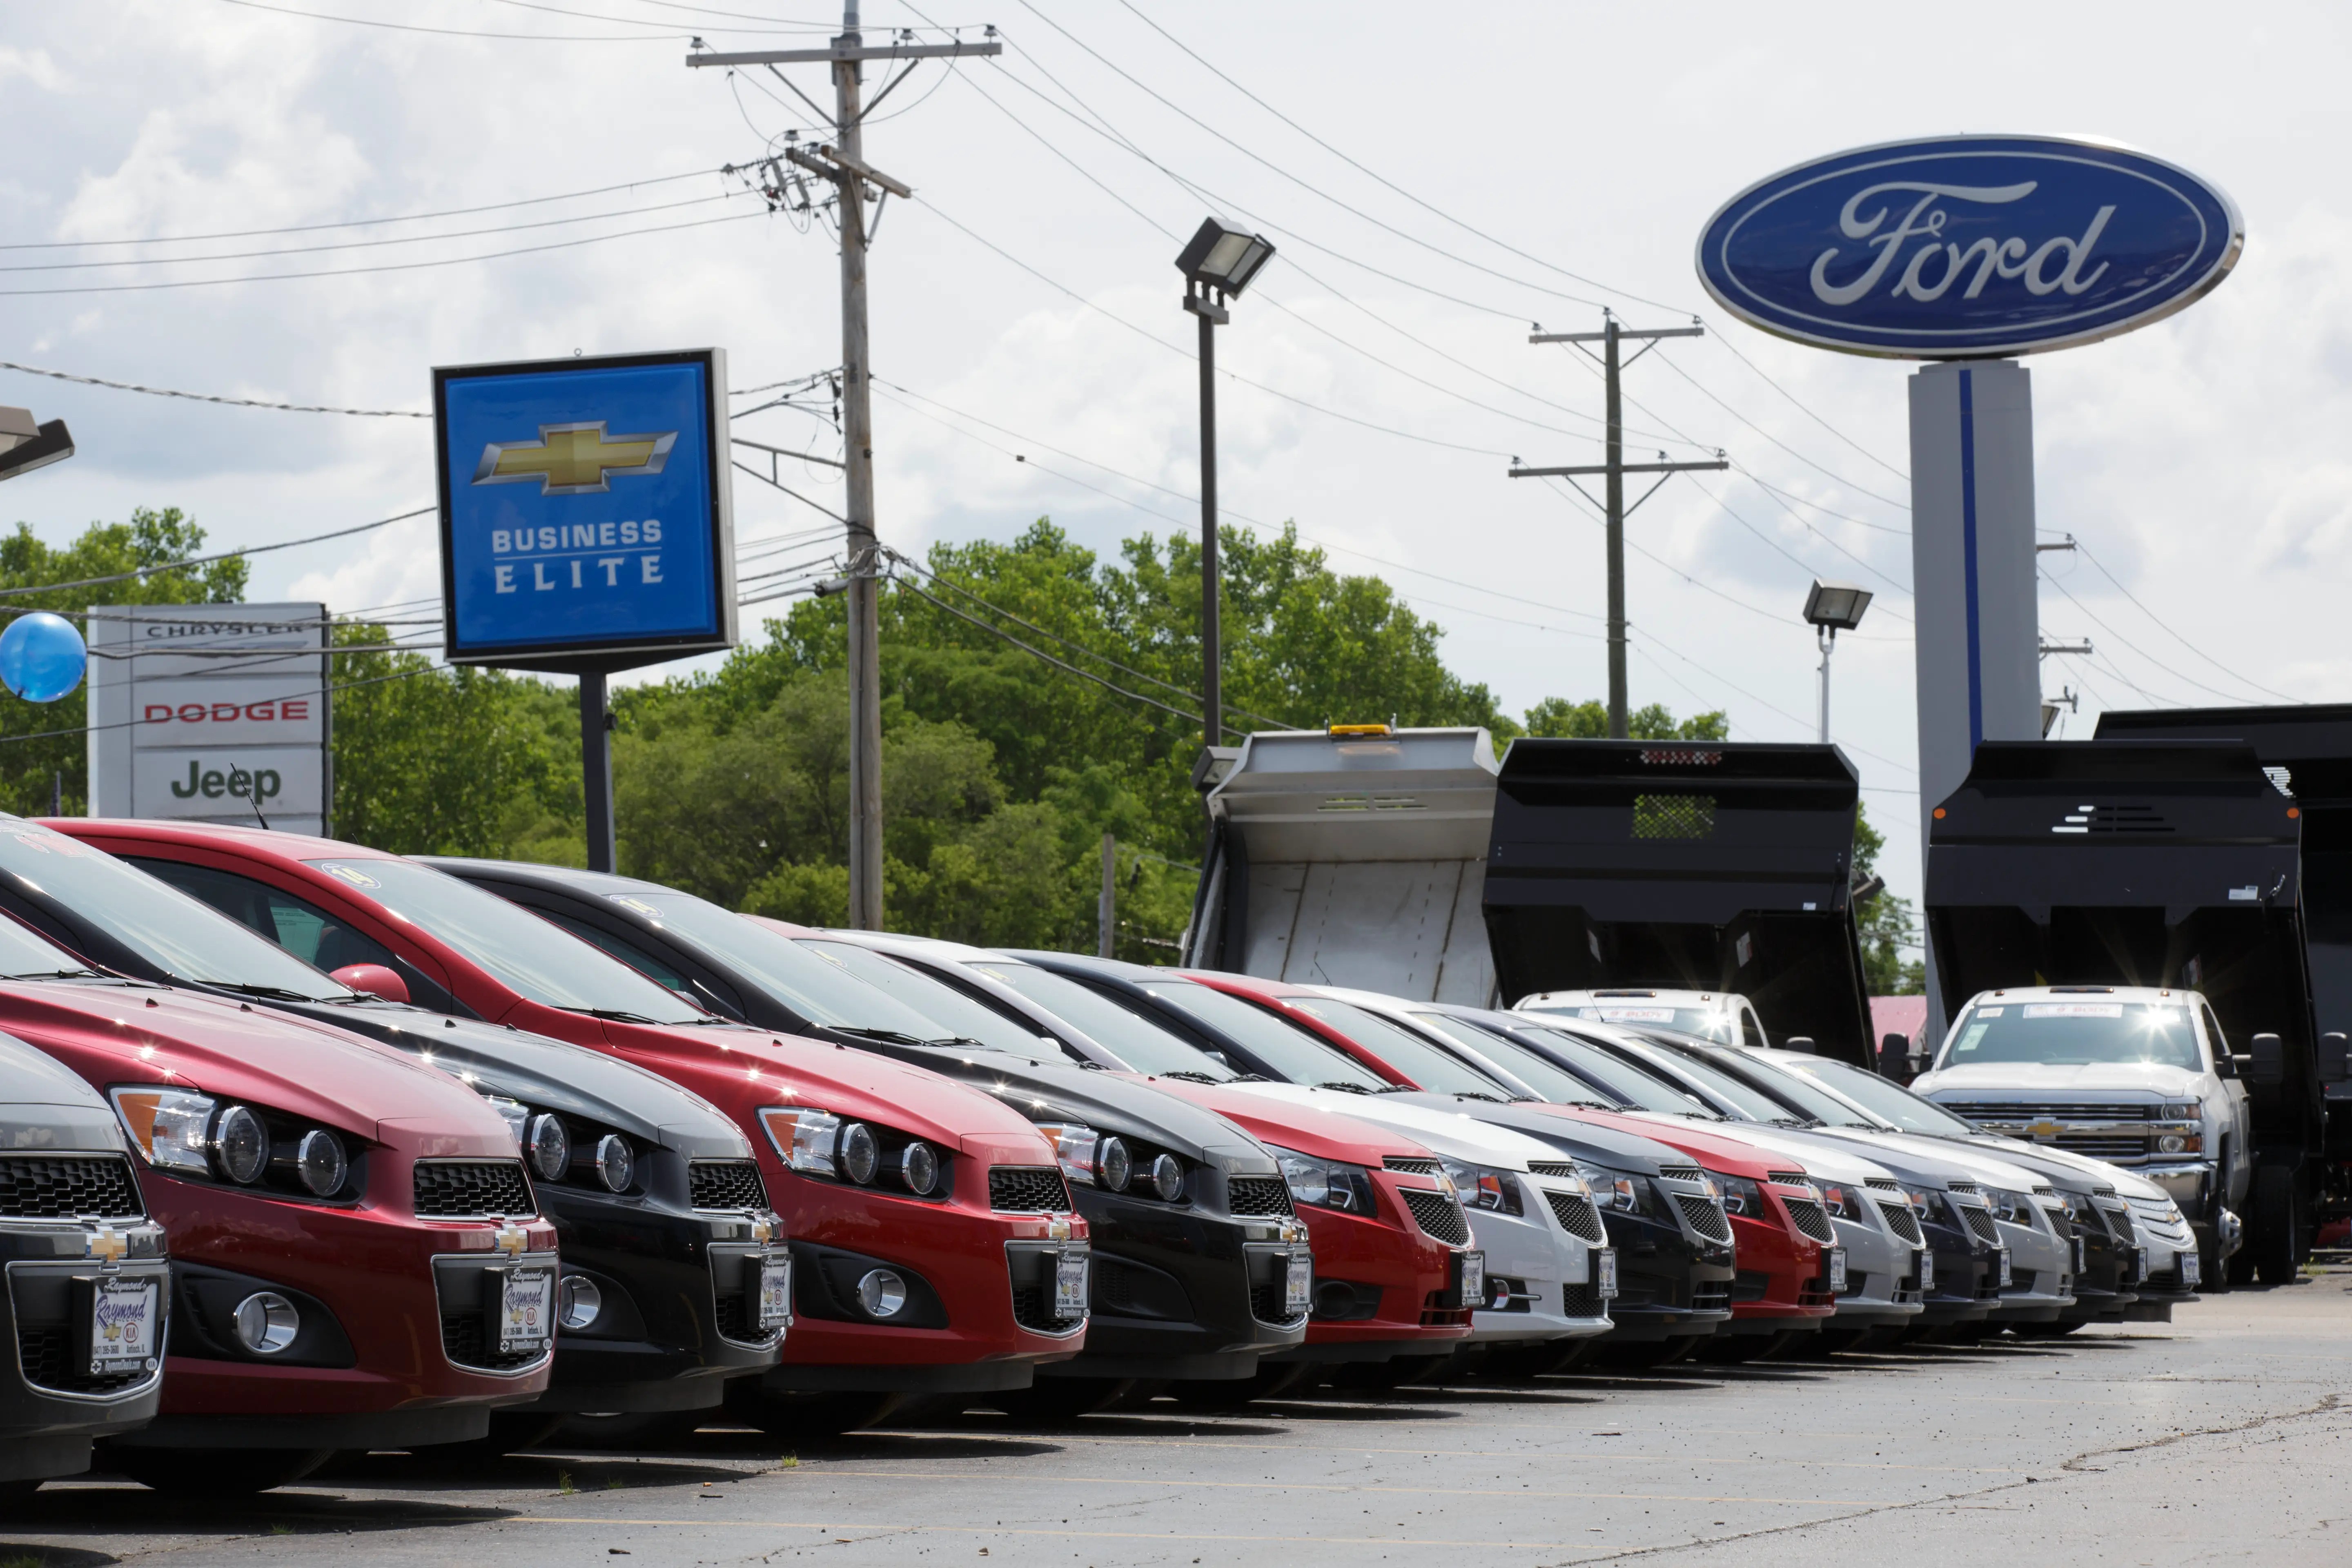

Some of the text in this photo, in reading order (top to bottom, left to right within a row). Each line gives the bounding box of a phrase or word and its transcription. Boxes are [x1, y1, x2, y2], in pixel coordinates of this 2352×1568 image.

[1810, 180, 2117, 305] Ford
[492, 519, 662, 553] BUSINESS
[494, 555, 664, 594] ELITE
[147, 624, 303, 637] CHRYSLER
[144, 701, 308, 722] DODGE
[171, 760, 281, 804] Jeep
[107, 1277, 145, 1295] Raymond
[514, 1268, 542, 1284] Raymond
[762, 1268, 786, 1294] Raymond
[1058, 1263, 1084, 1287] Raymond
[504, 1283, 544, 1313] Raymond
[95, 1294, 147, 1330] Raymond
[527, 1312, 535, 1321] KIA
[126, 1327, 136, 1339] KIA
